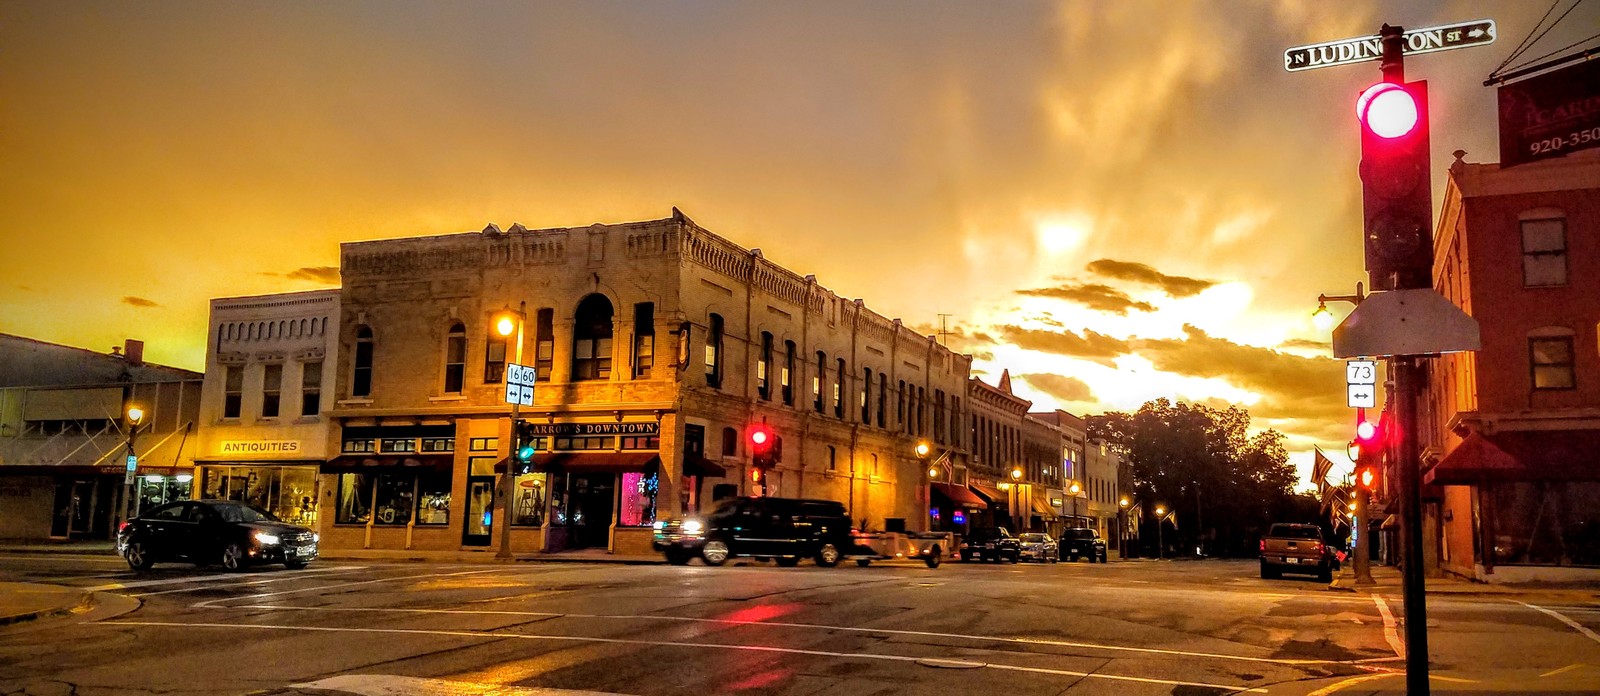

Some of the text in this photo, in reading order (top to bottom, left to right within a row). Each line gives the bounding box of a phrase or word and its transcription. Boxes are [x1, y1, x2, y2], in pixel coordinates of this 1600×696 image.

[1294, 54, 1304, 64] N
[1447, 30, 1462, 43] ST
[510, 368, 519, 380] 16
[523, 371, 535, 383] 60
[1351, 366, 1371, 379] 73
[586, 423, 654, 433] DOWNTOWN
[224, 442, 297, 452] ANTIQUITIES
